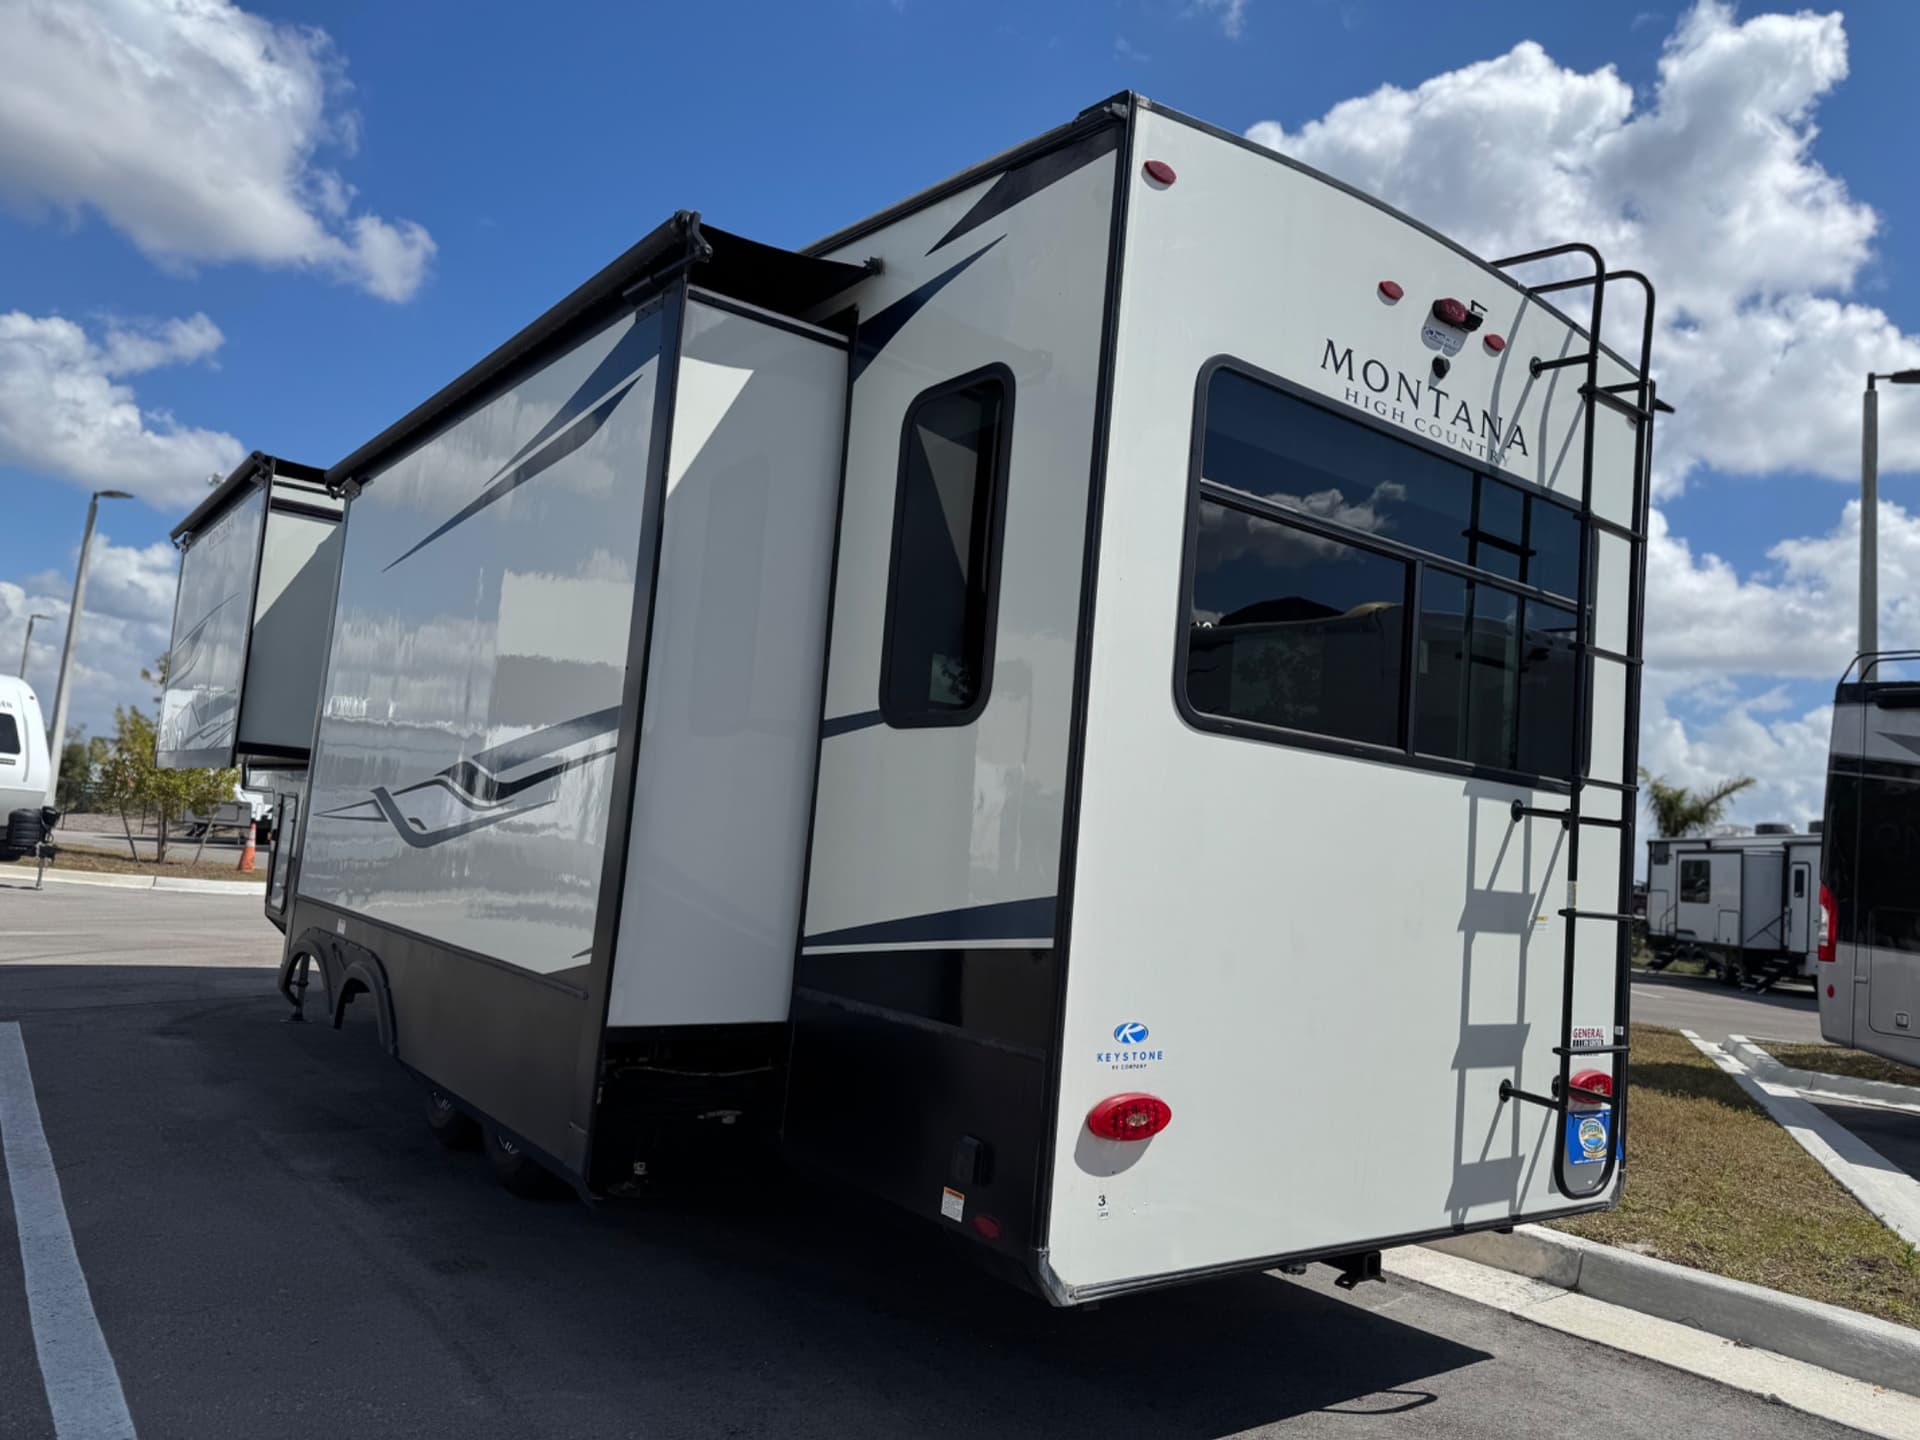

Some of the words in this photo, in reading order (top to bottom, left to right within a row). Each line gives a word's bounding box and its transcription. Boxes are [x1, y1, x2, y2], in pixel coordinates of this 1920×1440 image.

[1321, 338, 1528, 456] MONTANA
[1345, 387, 1406, 424] HIGH
[1414, 418, 1510, 467] COUNTRY
[1572, 1027, 1604, 1039] GENERAL
[1096, 1050, 1164, 1063] KEYSTONE
[1098, 1194, 1107, 1207] 3
